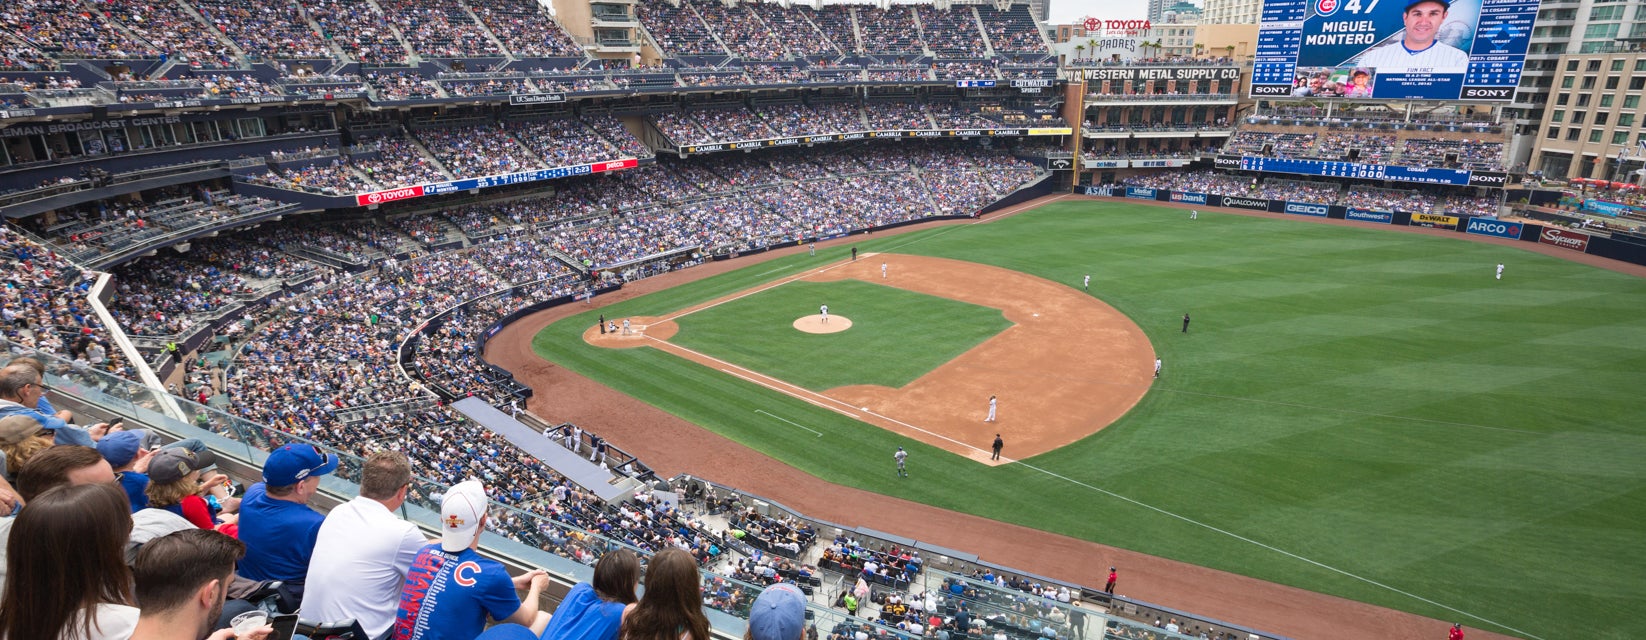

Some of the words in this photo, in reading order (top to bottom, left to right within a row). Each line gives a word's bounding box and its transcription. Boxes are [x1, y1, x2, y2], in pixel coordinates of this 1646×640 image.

[1344, 0, 1378, 14] 47
[1105, 20, 1151, 30] TOYOTA
[1322, 21, 1376, 33] MIGUEL
[1100, 39, 1136, 52] PADRES
[1306, 33, 1375, 46] MONTERO
[1084, 69, 1135, 80] WESTERN
[1139, 69, 1174, 80] METAL
[1177, 69, 1218, 80] SUPPLY
[1221, 68, 1239, 79] CO.
[1015, 79, 1048, 87] CUTWATER
[1466, 89, 1510, 97] SONY
[50, 120, 126, 133] BROADCAST
[132, 116, 181, 126] CENTER
[1471, 175, 1505, 183] SONY
[382, 189, 415, 200] TOYOTA
[1086, 187, 1112, 196] ASML
[1287, 203, 1327, 215] GEICO
[1349, 210, 1384, 220] Southwest
[1469, 221, 1506, 234] ARCO
[1546, 229, 1582, 246] Sycuan
